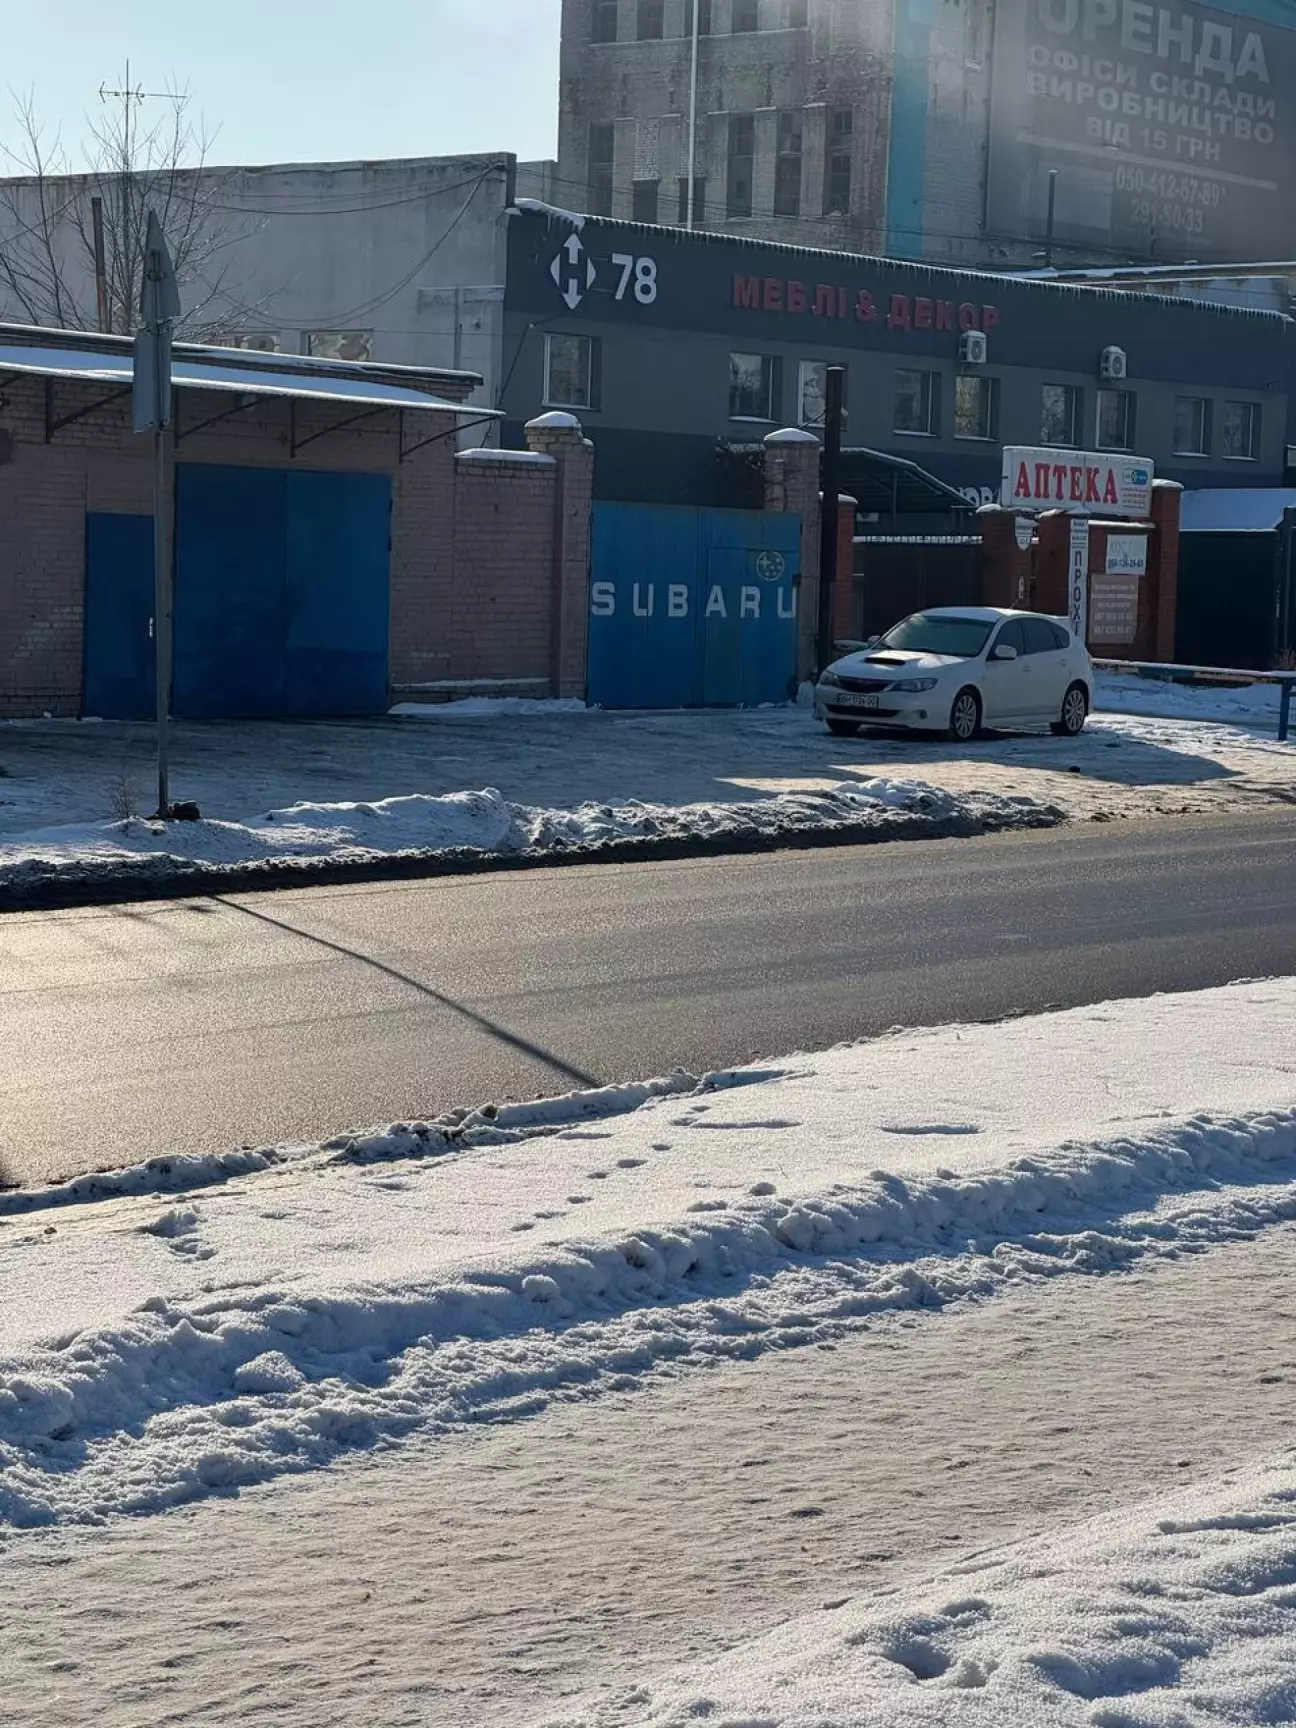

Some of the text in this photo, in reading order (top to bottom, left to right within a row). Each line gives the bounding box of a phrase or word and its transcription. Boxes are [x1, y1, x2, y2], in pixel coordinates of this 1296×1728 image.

[1038, 0, 1270, 84] ОРЕНДА
[1026, 70, 1275, 144] ВИРОБНИЦТВО
[1028, 44, 1276, 119] ОФІСИ СКЛАДИ
[1086, 116, 1221, 162] ВІД 15 ГРН
[611, 252, 657, 304] 78
[733, 274, 999, 332] МЕБЛІ & ДЕКОР
[1014, 461, 1118, 504] АПТЕКА
[591, 581, 797, 619] SUBARU
